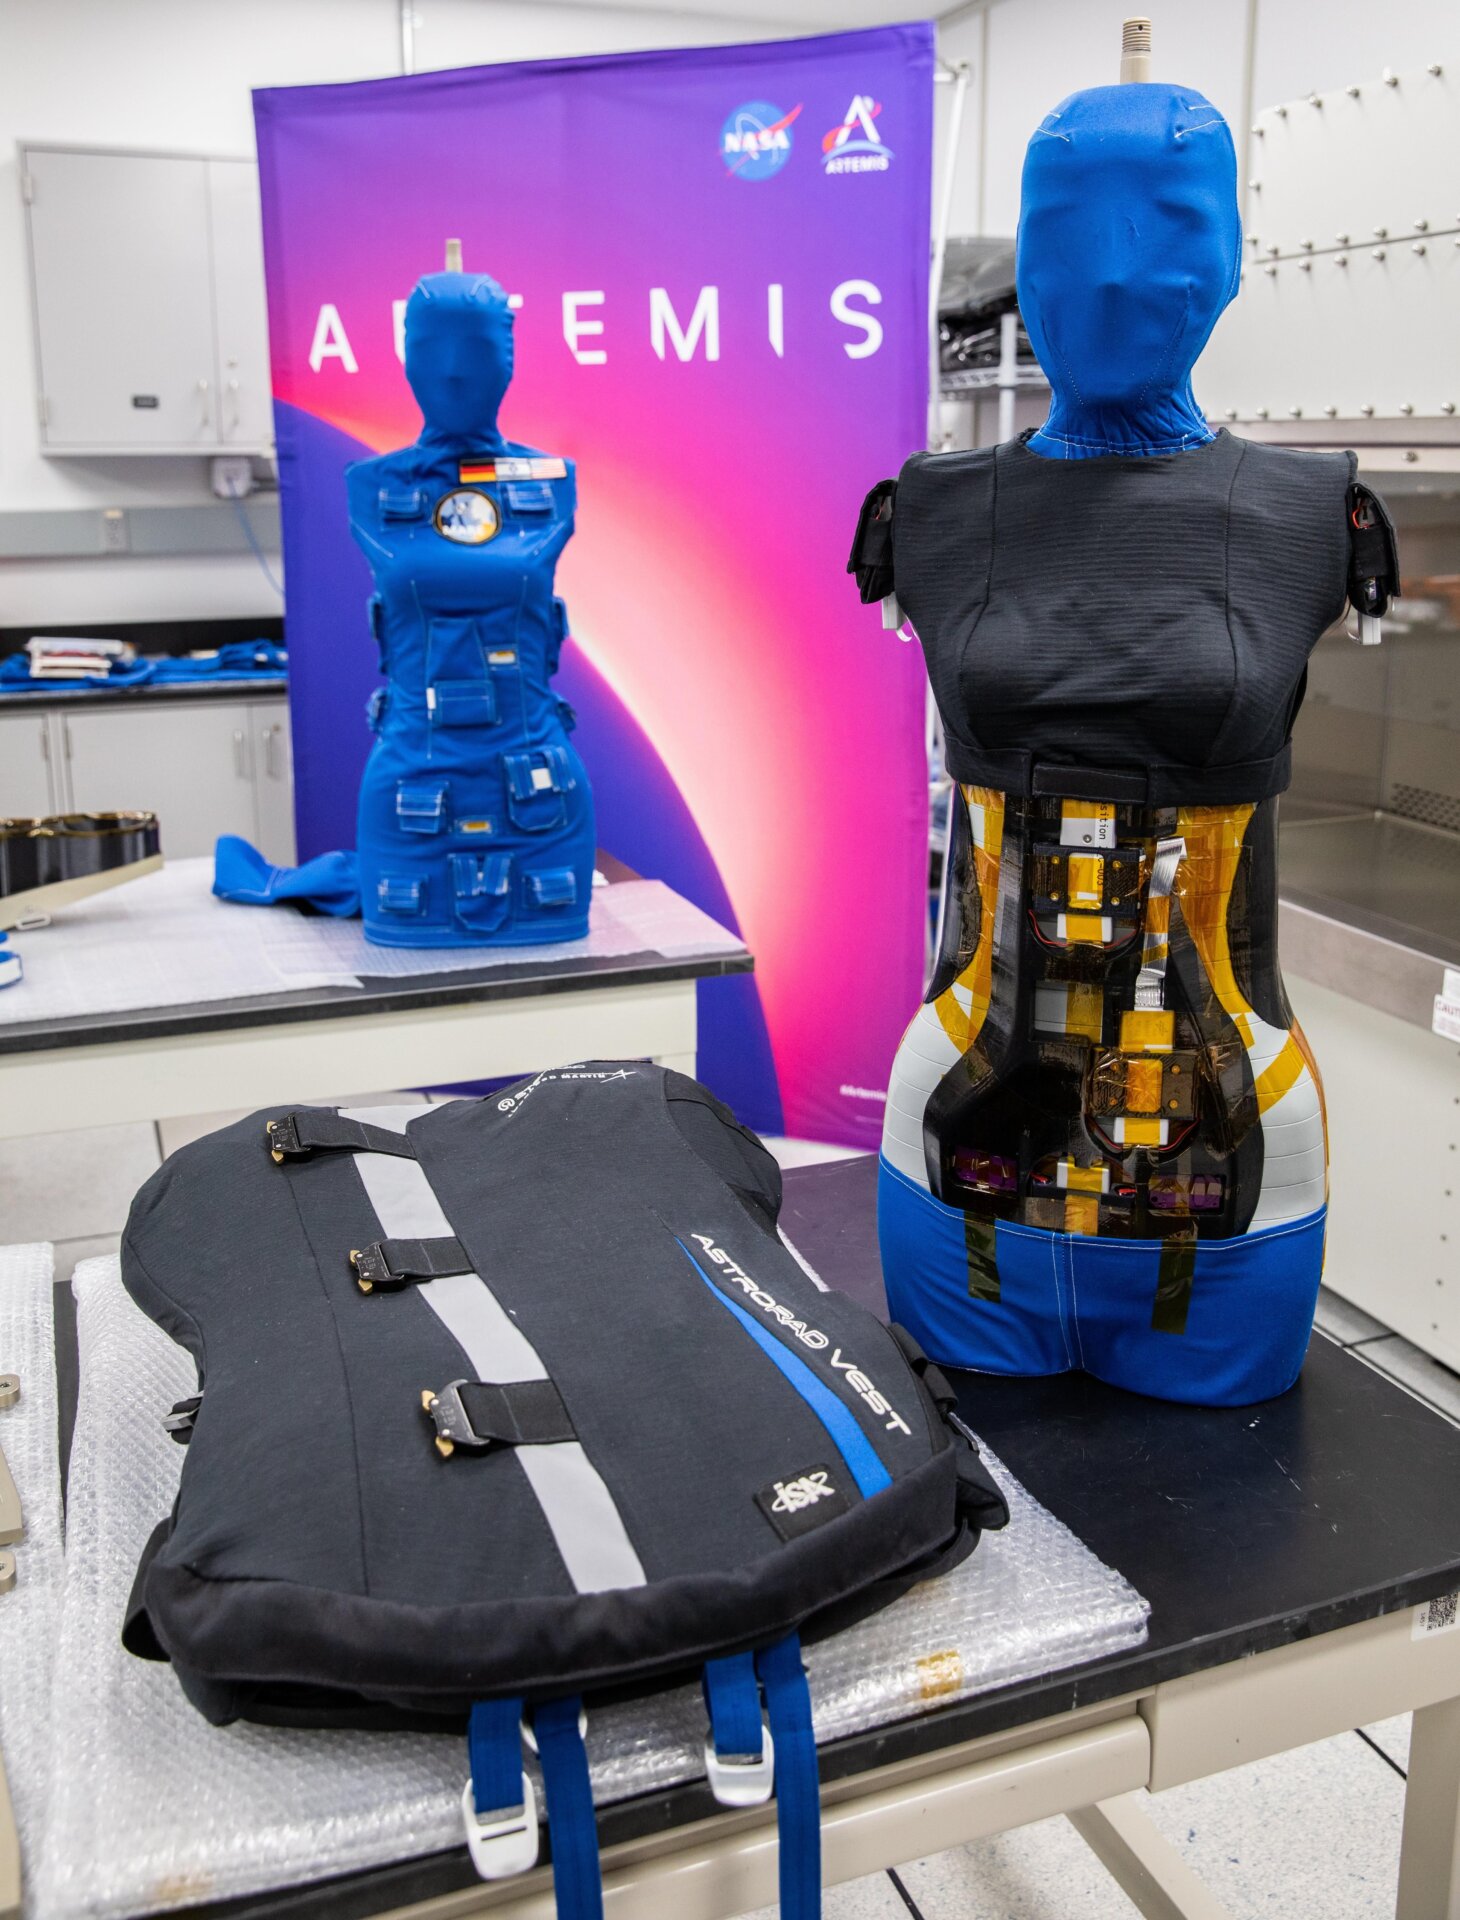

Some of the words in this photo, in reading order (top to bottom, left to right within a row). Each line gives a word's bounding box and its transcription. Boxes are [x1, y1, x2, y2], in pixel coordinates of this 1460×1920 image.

[724, 128, 791, 153] NASA
[825, 154, 889, 175] ARTEMIS
[1098, 804, 1110, 840] sition
[690, 1233, 829, 1349] ASTRORAD
[830, 1348, 912, 1435] VEST
